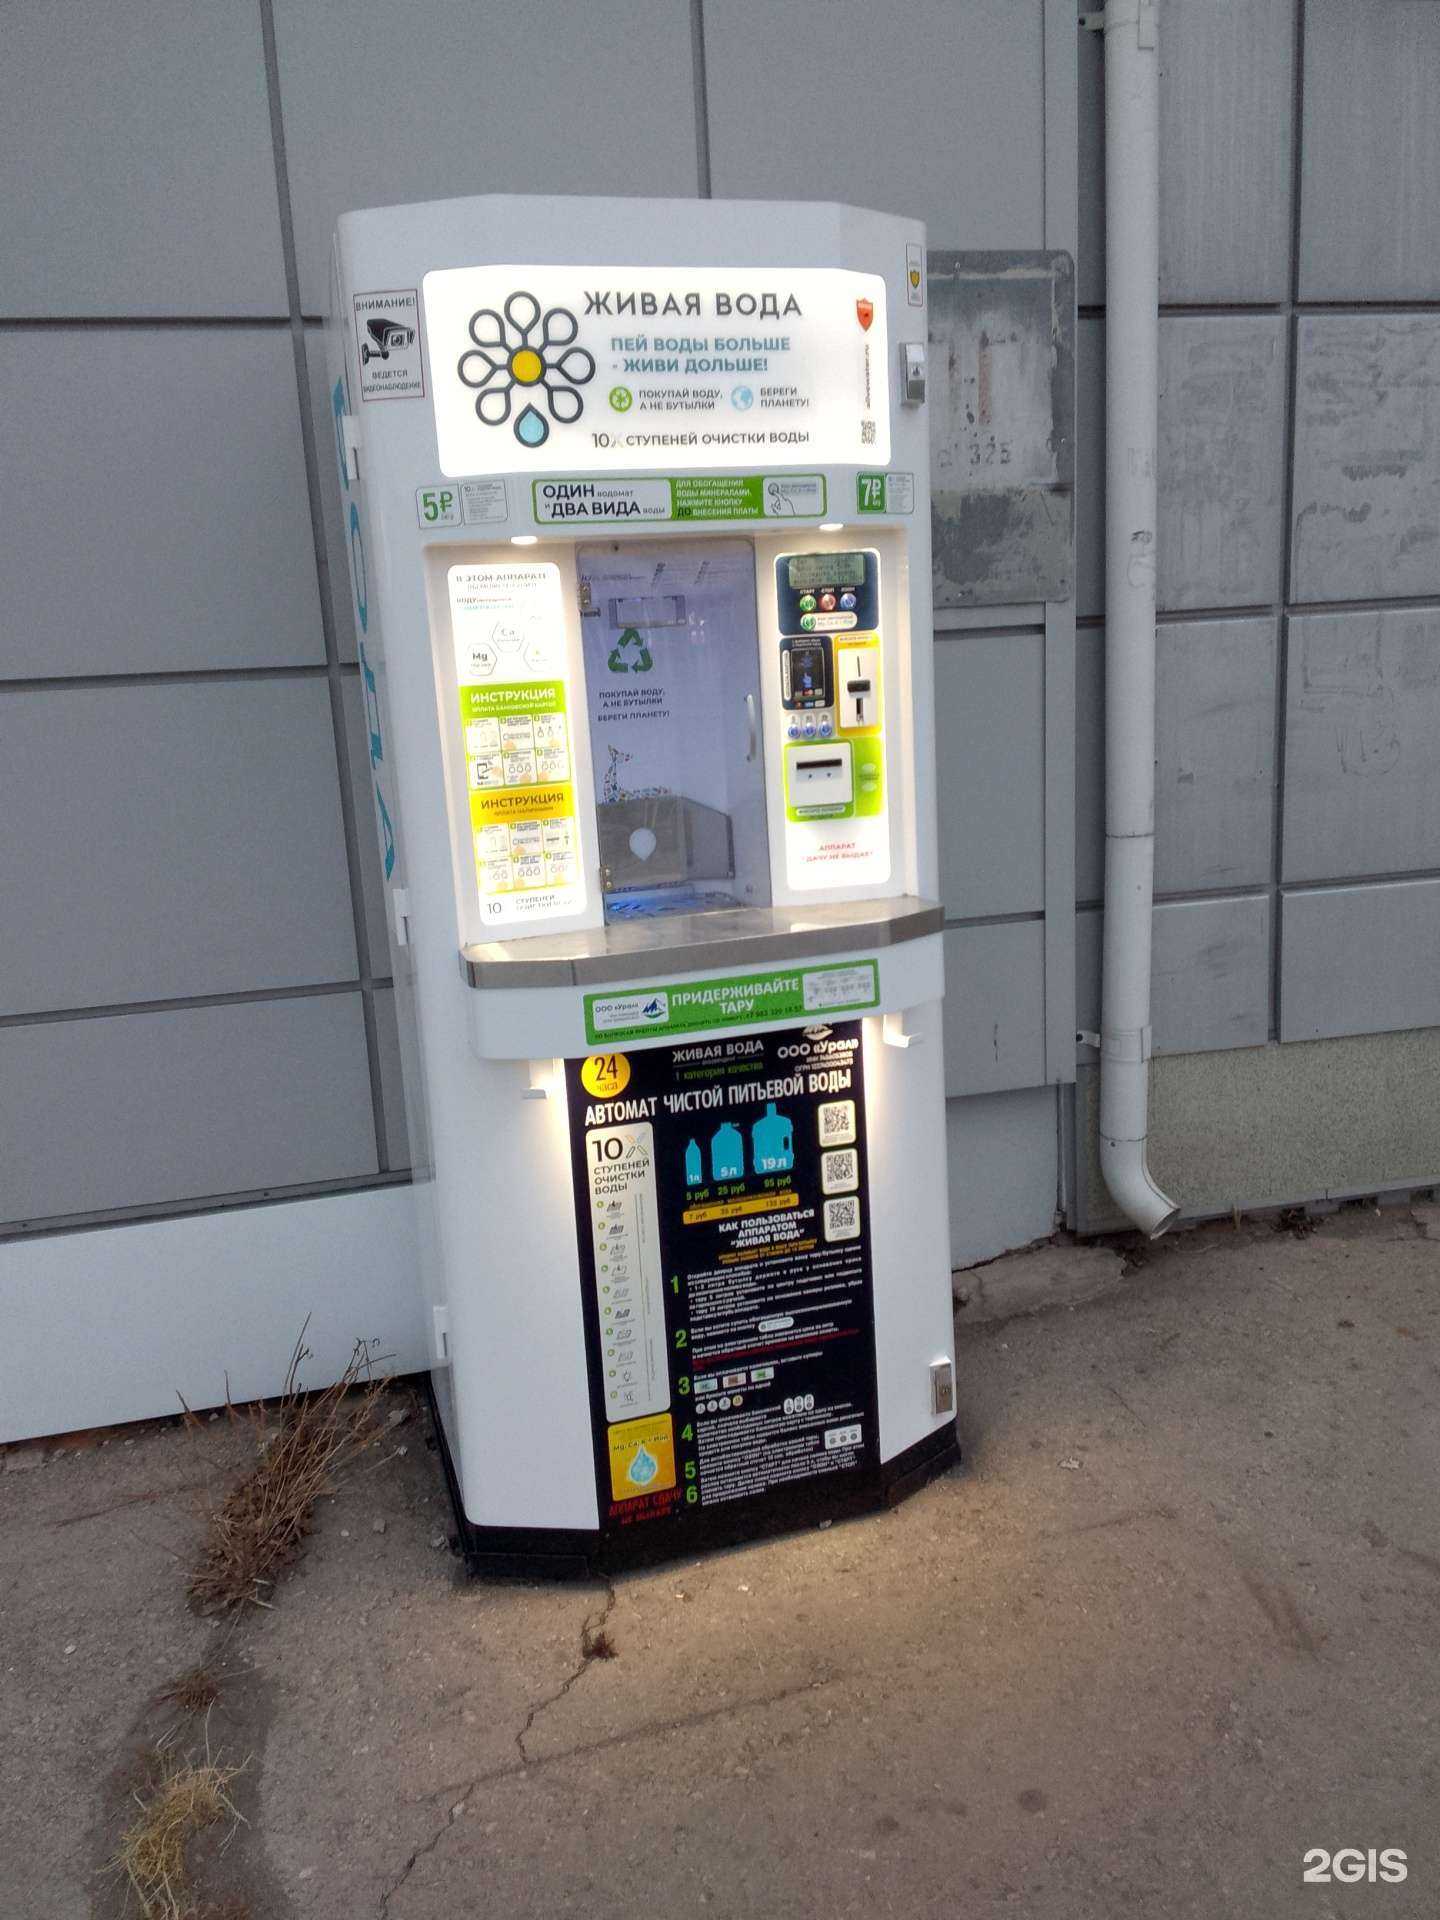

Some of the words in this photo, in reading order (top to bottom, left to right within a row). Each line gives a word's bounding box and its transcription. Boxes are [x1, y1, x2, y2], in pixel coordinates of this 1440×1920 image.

[355, 296, 416, 311] ВНИМАНИЕ!
[584, 291, 701, 316] ЖИВАЯ
[715, 292, 802, 320] ВОДА
[611, 334, 648, 352] ПЕЙ
[653, 337, 709, 354] ВОДЫ
[714, 336, 791, 351] БОЛЬШЕ
[623, 358, 679, 373] ЖИВИ
[685, 357, 768, 374] ДОЛЬШЕ!
[639, 387, 690, 400] ПОКУПАЙ
[760, 386, 797, 397] БЕРЕГИ
[639, 402, 648, 411] А
[650, 402, 663, 411] НЕ
[666, 401, 716, 411] БУТЫЛКИ
[760, 398, 810, 409] ПЛАНЕТУ!
[592, 432, 610, 448] 10
[626, 431, 698, 447] СТУПЕНЕЙ
[702, 432, 765, 445] ОЧИСТКИ
[769, 432, 809, 444] ВОДЫ
[542, 484, 595, 500] ОДИН
[551, 502, 588, 518] ДВА
[592, 501, 640, 517] ВИДА
[473, 652, 488, 662] Mg
[470, 687, 556, 704] ИНСТРУКЦИЯ
[599, 688, 639, 699] ПОКУПАЙ
[481, 792, 564, 809] ИНСТРУКЦИЯ
[487, 902, 502, 914] 10
[672, 977, 800, 1007] ПРИДЕРЖИВАЙТЕ
[719, 999, 754, 1015] ТАРУ
[672, 1045, 722, 1062] ЖИВАЯ
[726, 1040, 764, 1055] ВОДА
[778, 1043, 810, 1059] ООО
[594, 1055, 619, 1081] 24
[585, 1097, 658, 1126] АВТОМАТ
[663, 1085, 723, 1114] ЧИСТОЙ
[729, 1073, 804, 1105] ПИТЬЕВОЙ
[809, 1069, 852, 1093] ВОДЫ
[592, 1137, 624, 1162] 10
[594, 1159, 650, 1175] СТУПЕНЕЙ
[594, 1170, 645, 1185] ОЧИСТКИ
[777, 1175, 792, 1187] руб
[595, 1183, 628, 1195] ВОДЫ
[694, 1188, 710, 1201] руб
[731, 1183, 746, 1195] руб
[718, 1222, 738, 1233] КАК
[741, 1208, 815, 1229] ПОЛЬЗОВАТЬСЯ
[738, 1221, 797, 1238] АППАРАТОМ
[671, 1274, 679, 1296] 1
[675, 1329, 687, 1349] 2
[678, 1376, 691, 1396] 3
[681, 1423, 694, 1442] 4
[685, 1460, 697, 1480] 5
[686, 1485, 698, 1504] 6
